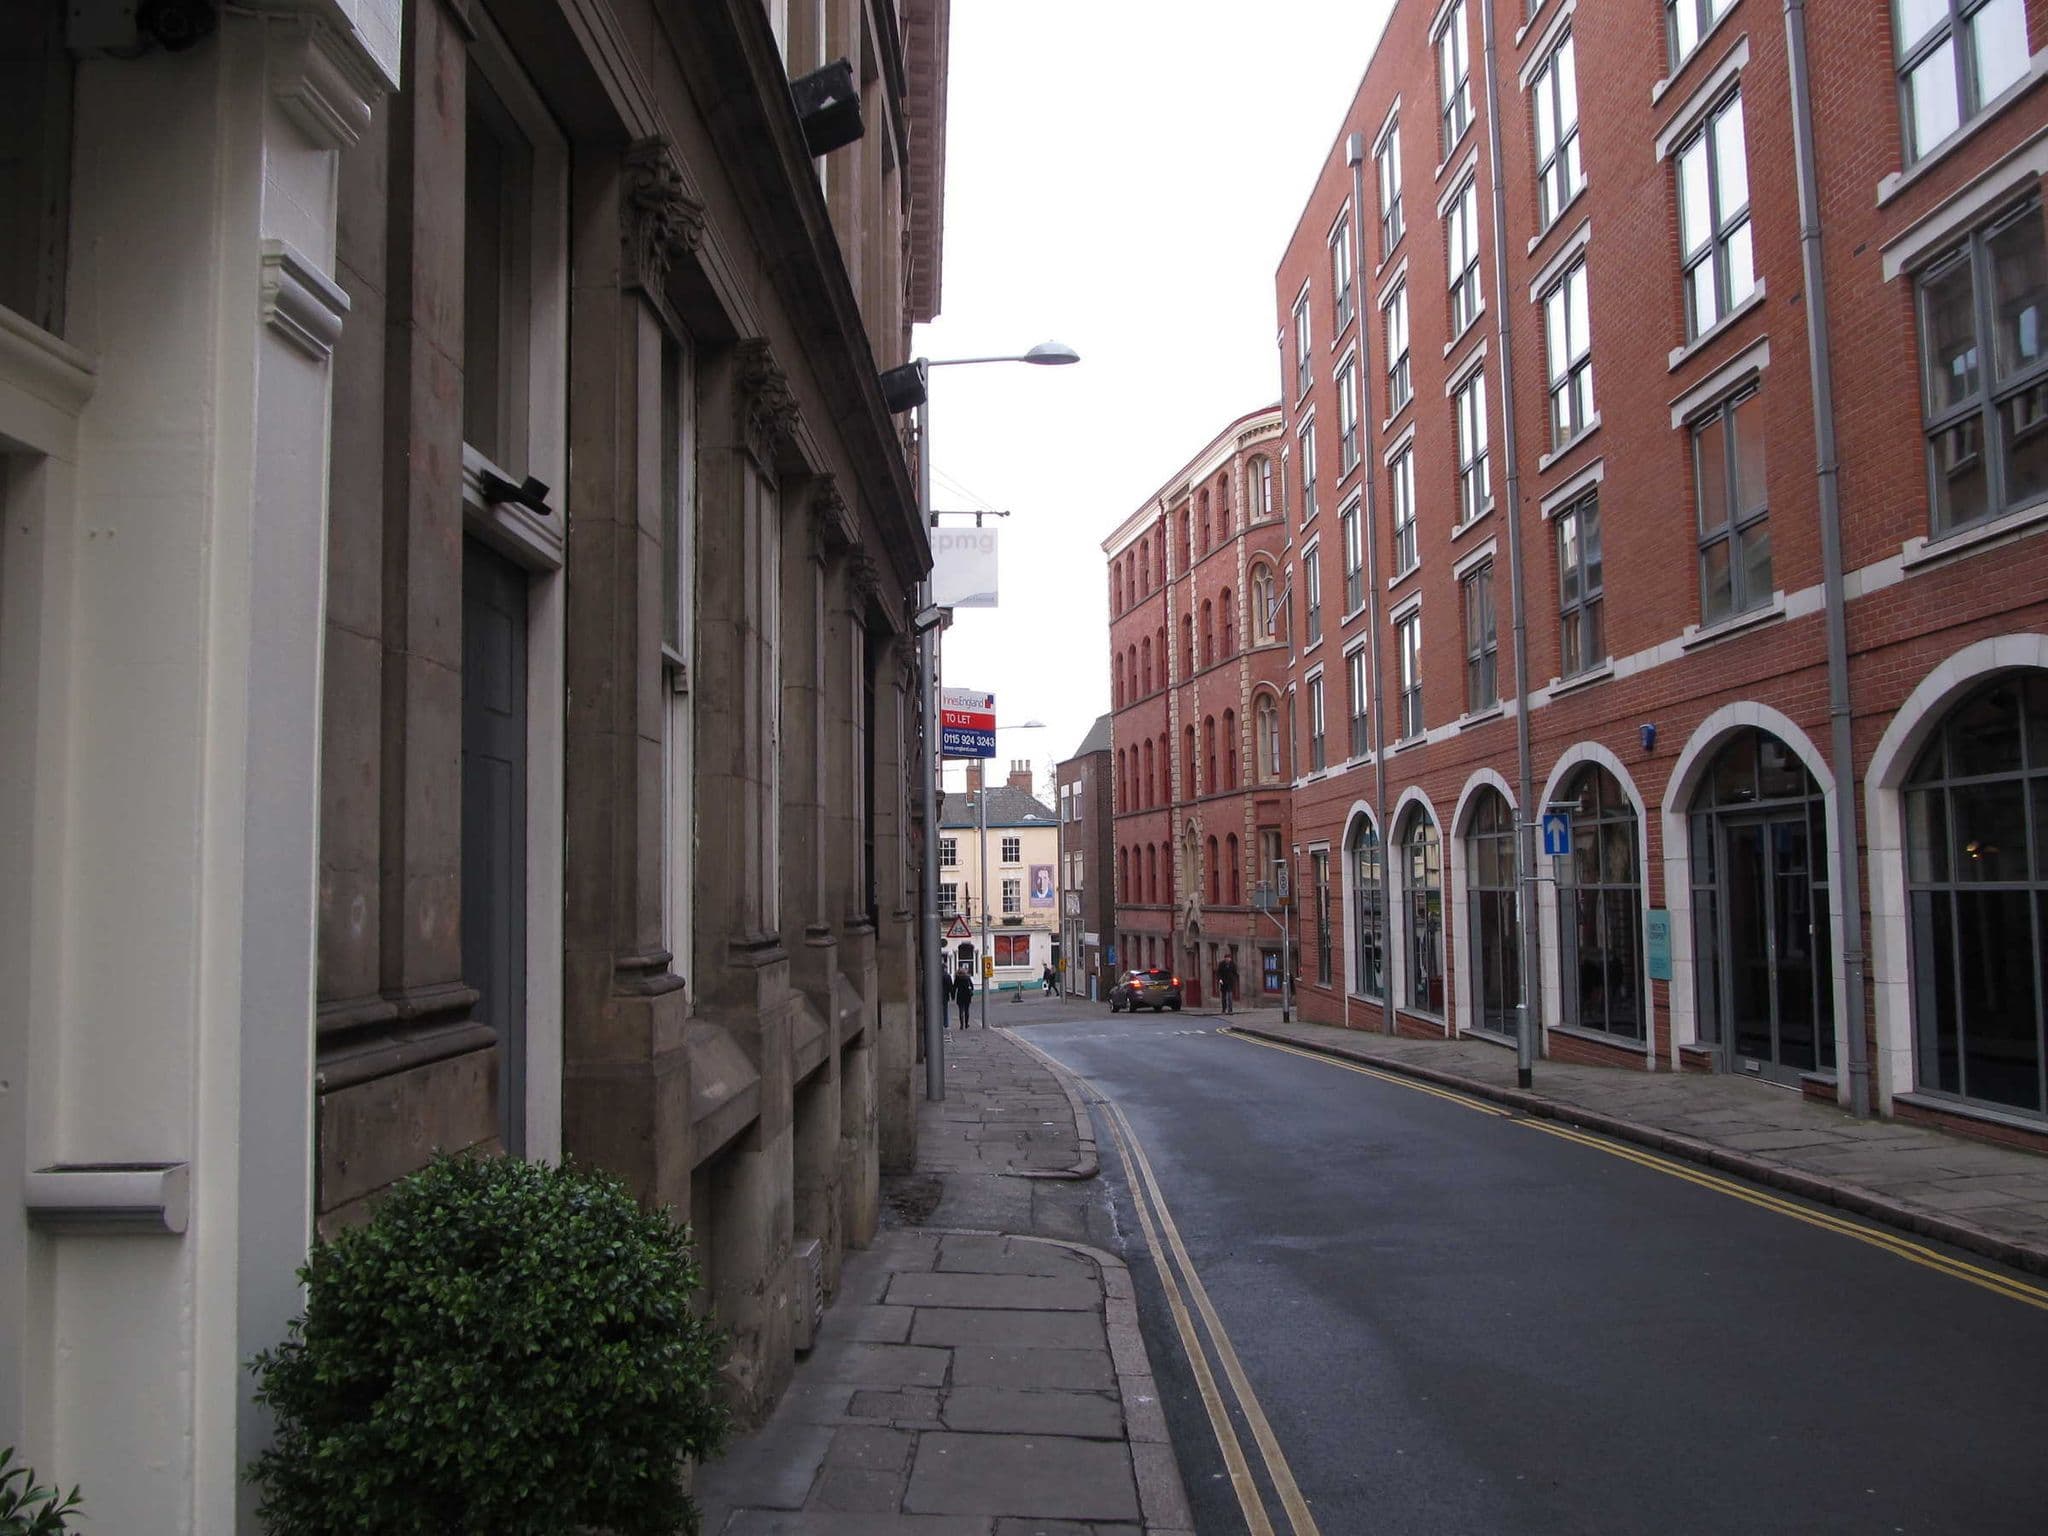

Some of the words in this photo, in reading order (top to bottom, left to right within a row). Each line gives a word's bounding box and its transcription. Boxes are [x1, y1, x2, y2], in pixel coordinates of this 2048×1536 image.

[946, 713, 956, 723] TO
[957, 714, 970, 724] LET
[944, 733, 960, 744] 0115
[961, 735, 975, 745] 924
[976, 736, 994, 747] 3243
